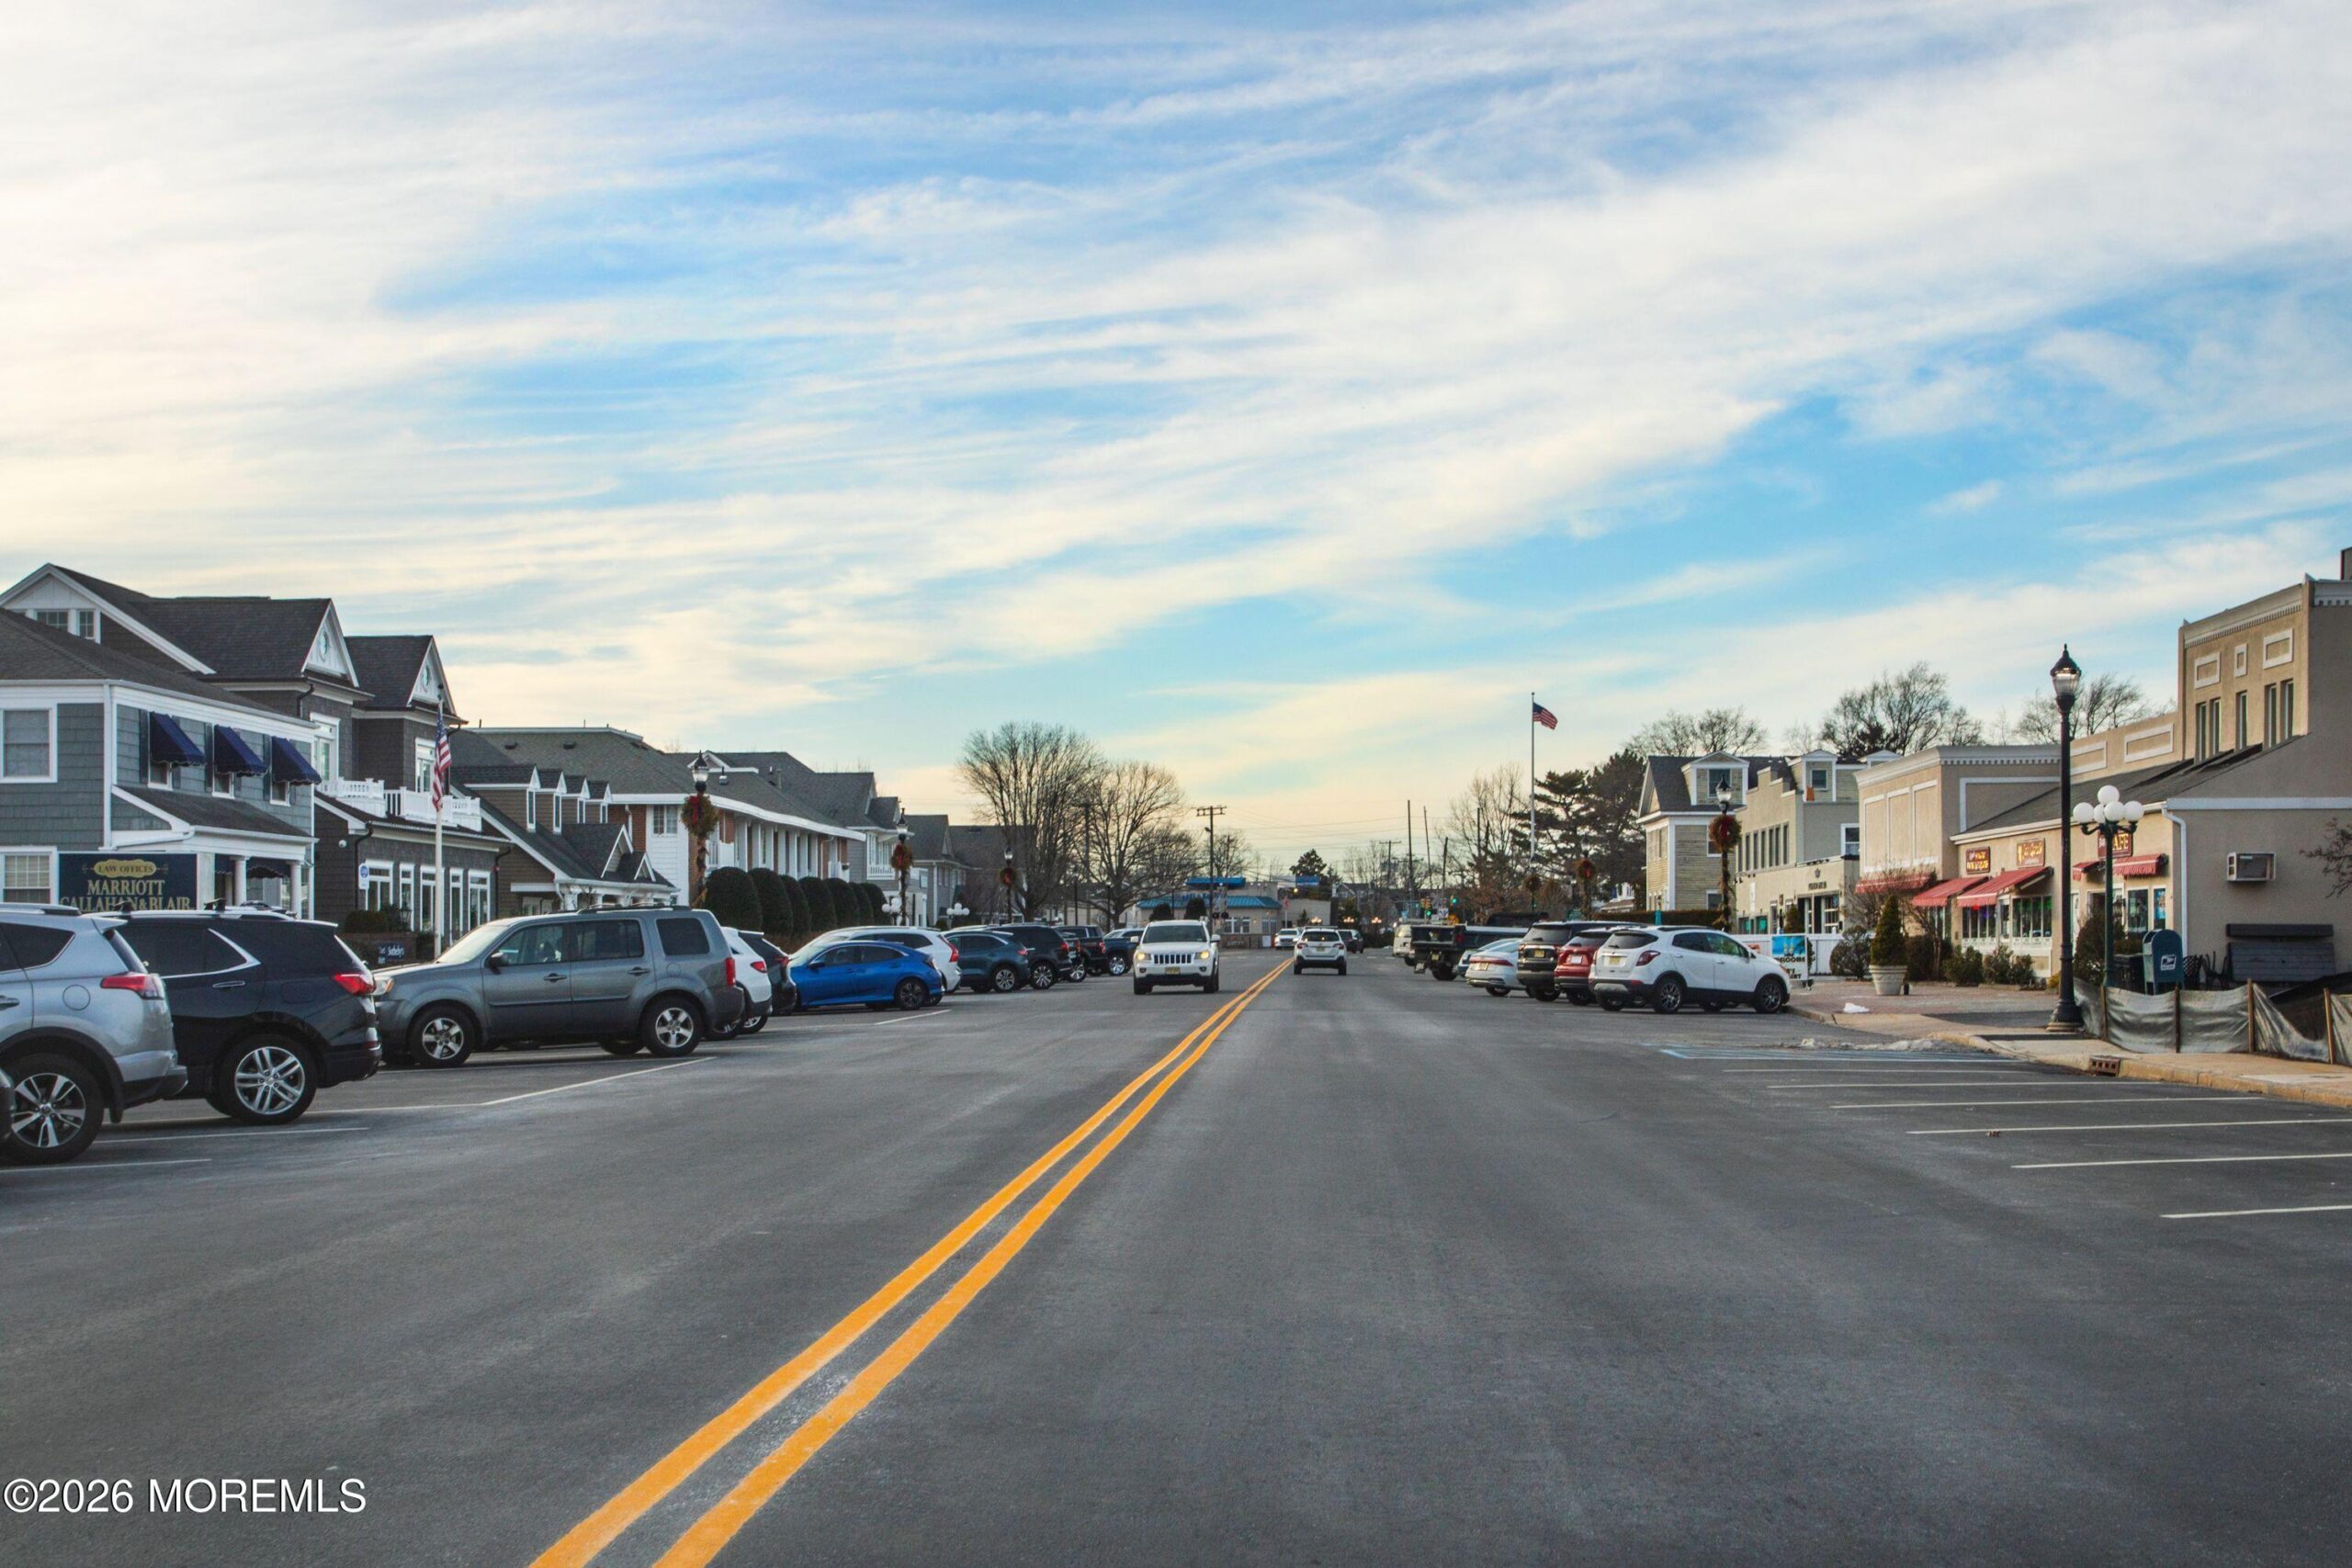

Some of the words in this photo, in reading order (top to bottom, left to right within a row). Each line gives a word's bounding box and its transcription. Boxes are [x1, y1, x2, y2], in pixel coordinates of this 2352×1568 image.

[2112, 832, 2129, 851] AFE
[98, 864, 118, 873] LAW
[119, 864, 153, 873] OFFICES
[87, 879, 165, 896] MARRIOTT
